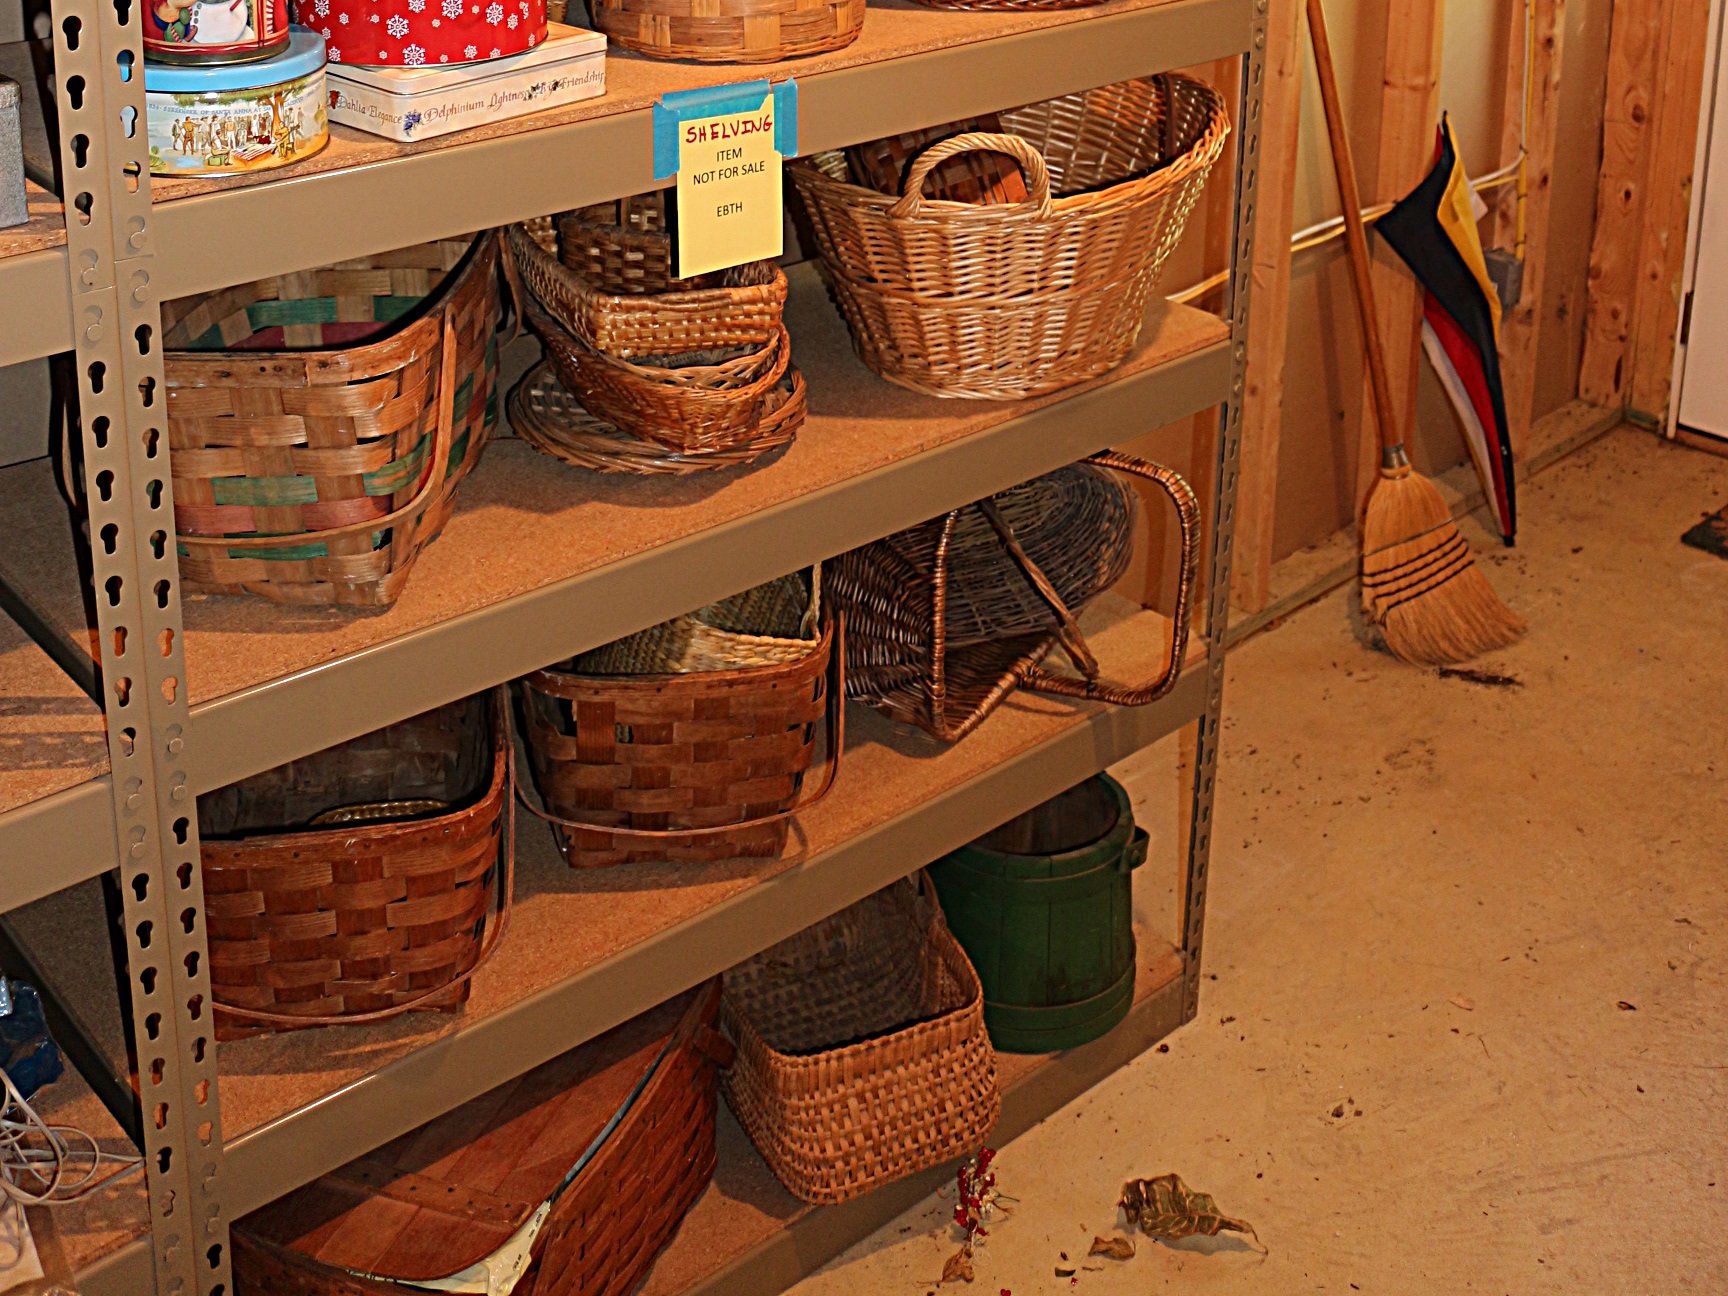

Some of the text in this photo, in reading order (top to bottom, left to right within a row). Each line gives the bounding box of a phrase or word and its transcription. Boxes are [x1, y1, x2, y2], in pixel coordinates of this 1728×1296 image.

[338, 94, 403, 125] Dahlia Elegance
[423, 100, 485, 123] Delphinium
[685, 114, 773, 144] SHELVING
[716, 147, 743, 163] ITEM
[693, 161, 766, 185] NOT FOR SALE
[716, 201, 743, 218] EBTH
